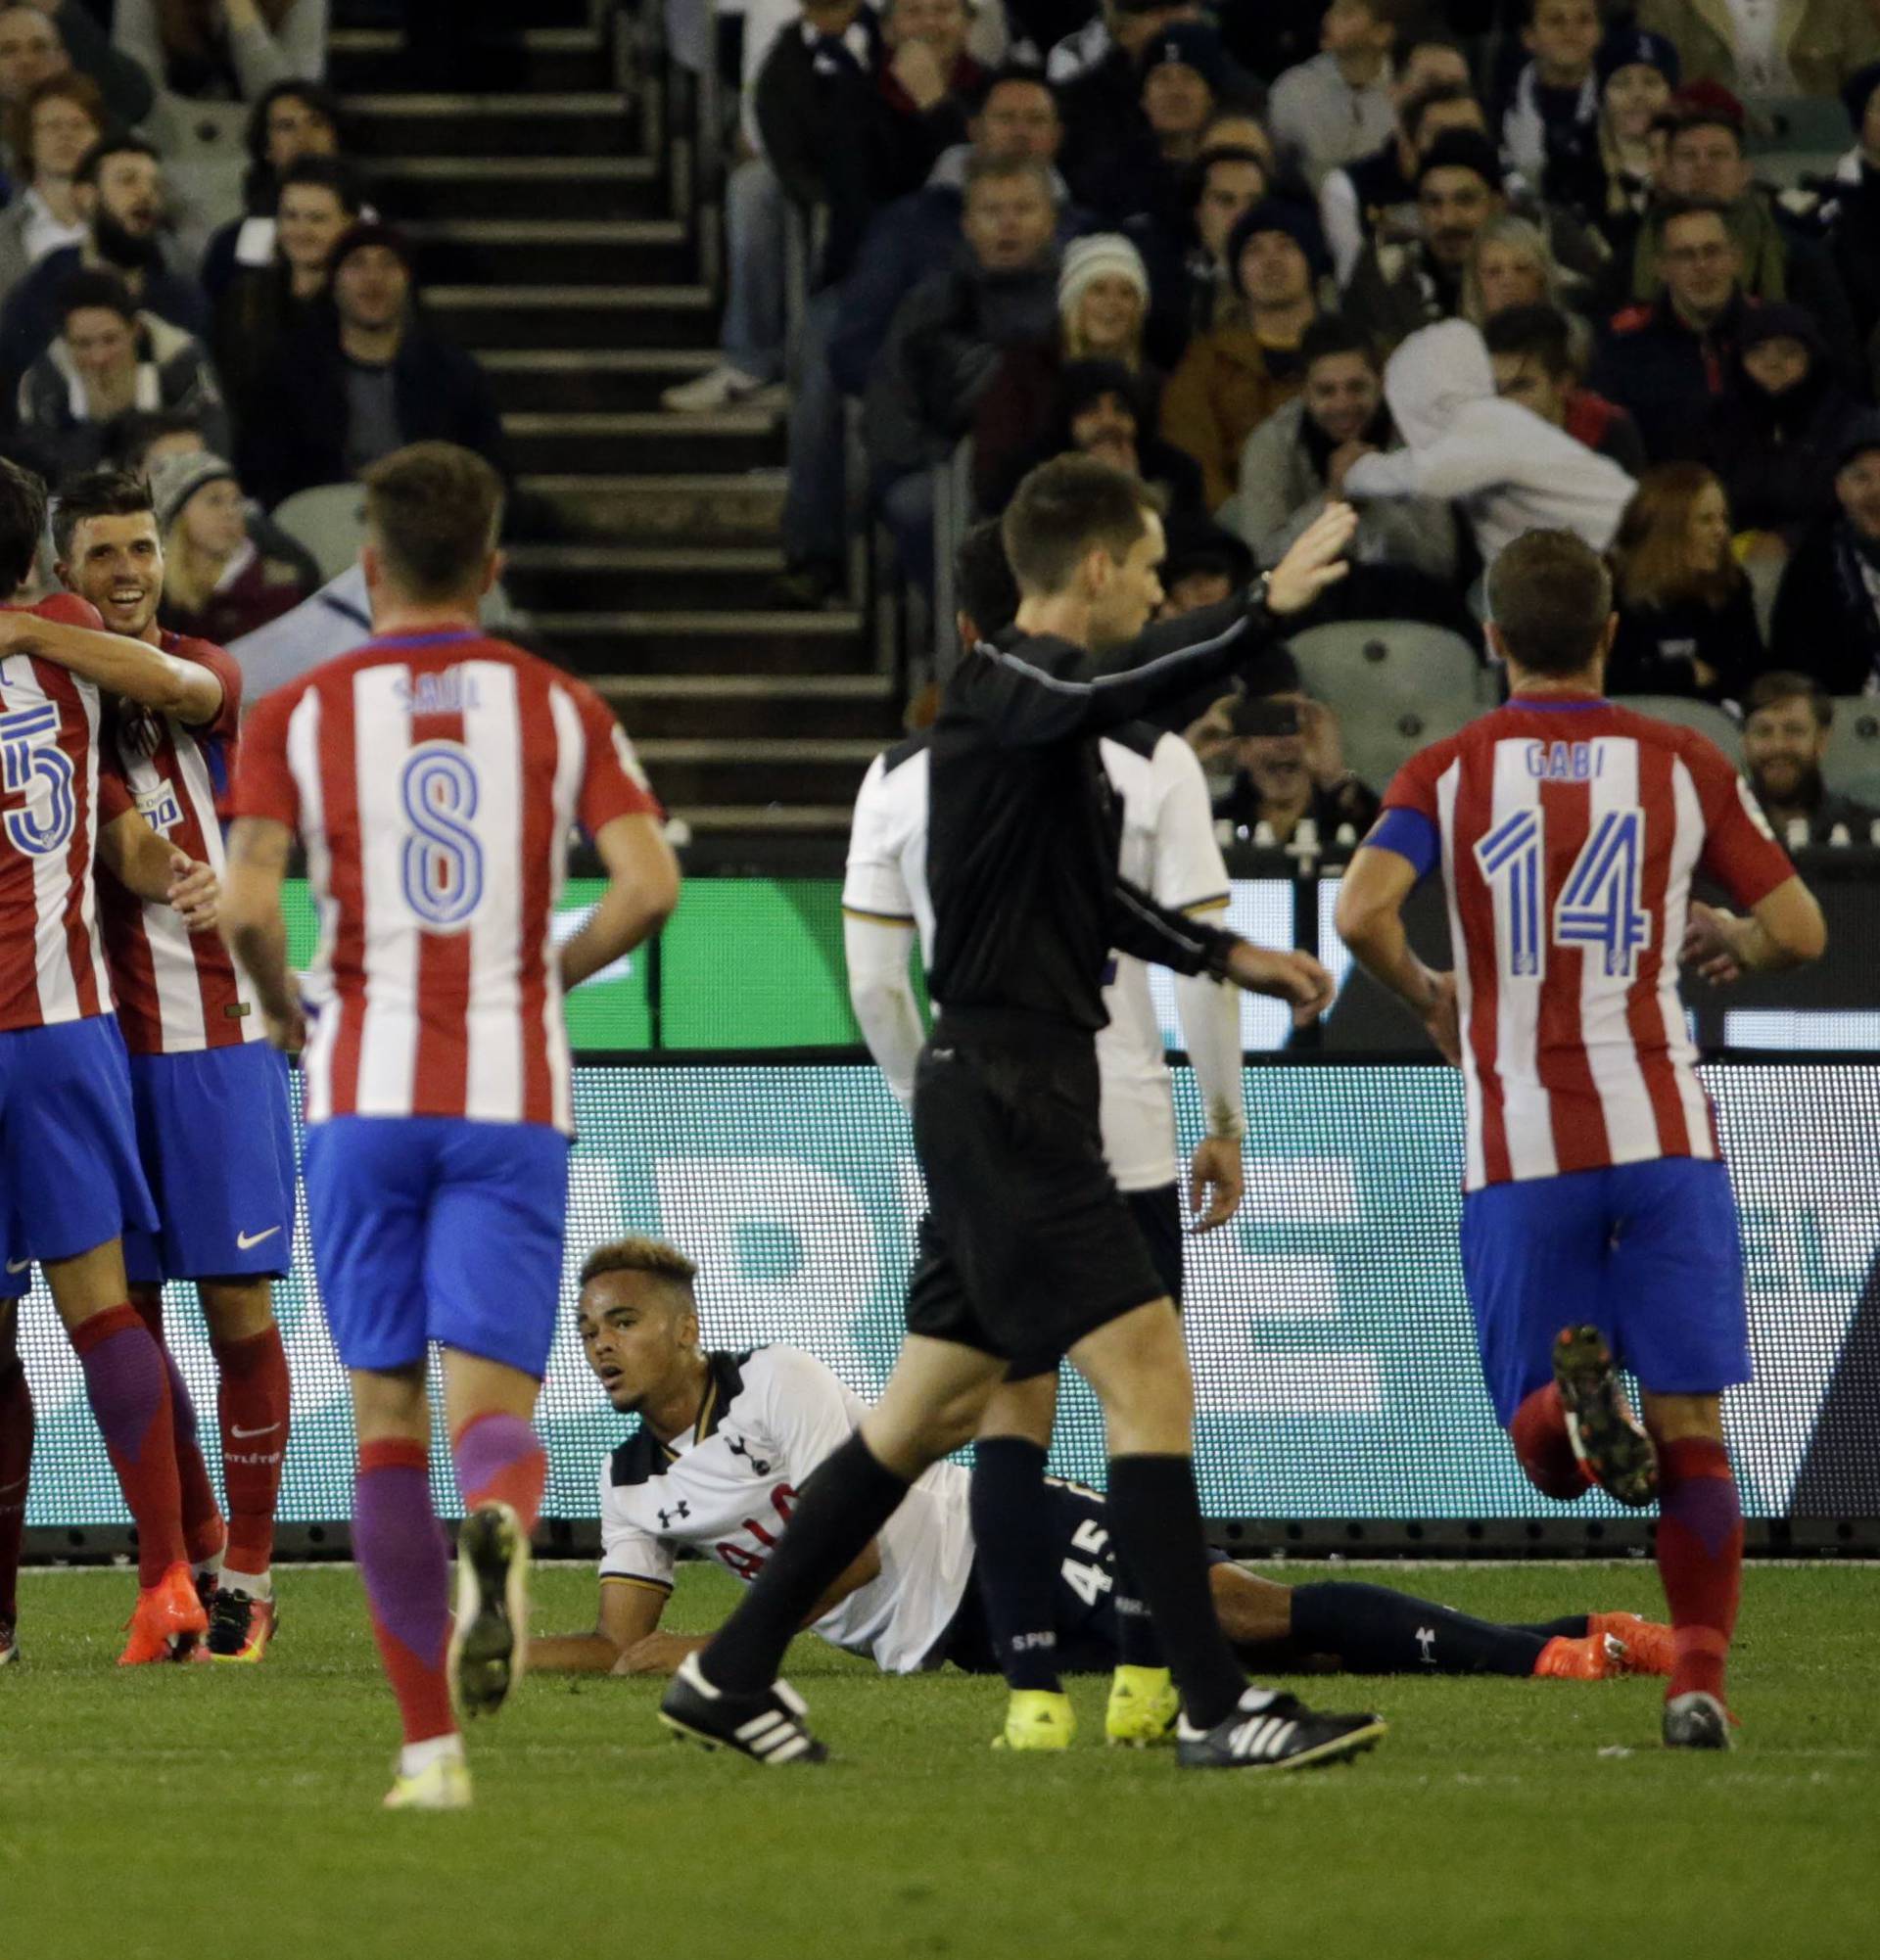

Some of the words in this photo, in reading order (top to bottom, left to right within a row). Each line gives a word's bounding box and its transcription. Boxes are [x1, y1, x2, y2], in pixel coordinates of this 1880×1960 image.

[1527, 743, 1604, 777] GABI
[400, 746, 485, 926] 8
[1477, 808, 1648, 979] 14
[1060, 1518, 1114, 1607] 45
